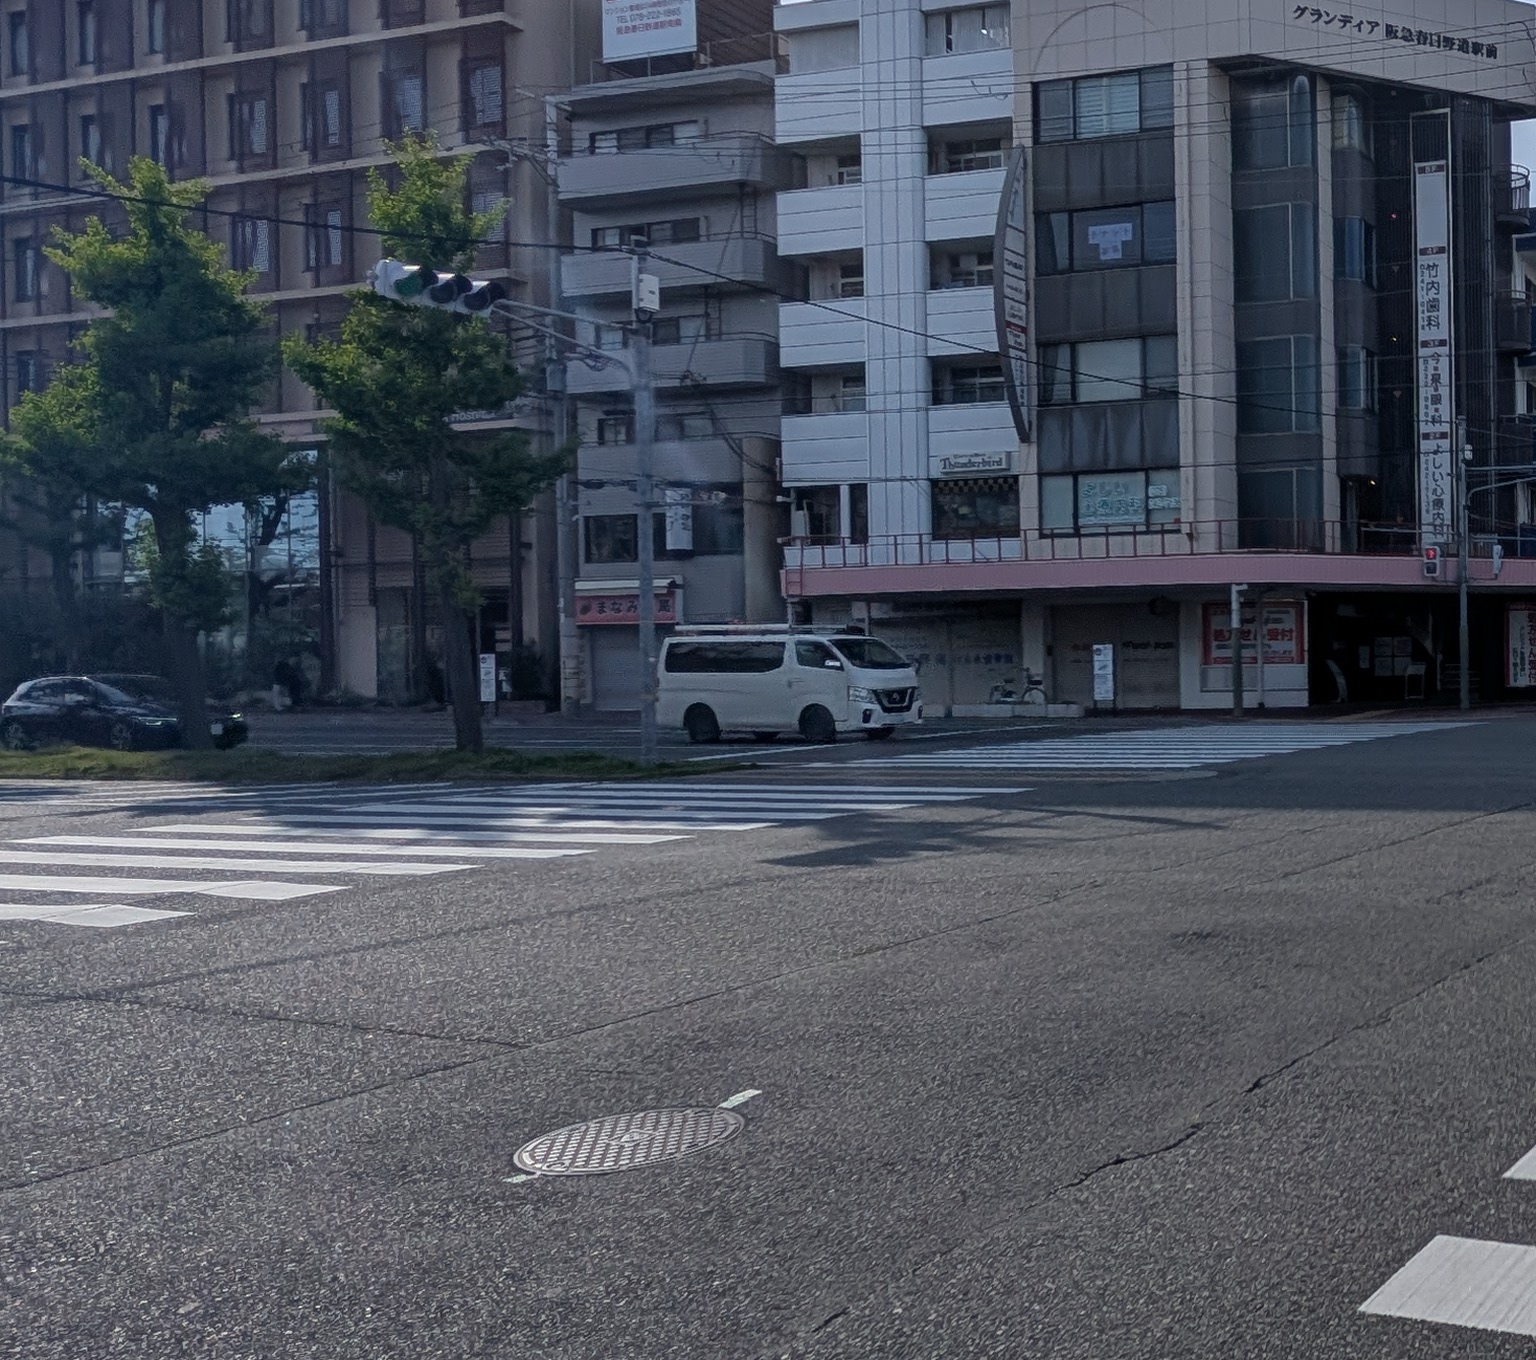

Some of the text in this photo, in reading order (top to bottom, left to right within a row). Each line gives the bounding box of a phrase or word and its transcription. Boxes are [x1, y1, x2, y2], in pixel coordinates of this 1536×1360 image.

[1293, 4, 1498, 60] グランディア 阪急春日野道駅前
[1425, 262, 1441, 331] 竹内歯科
